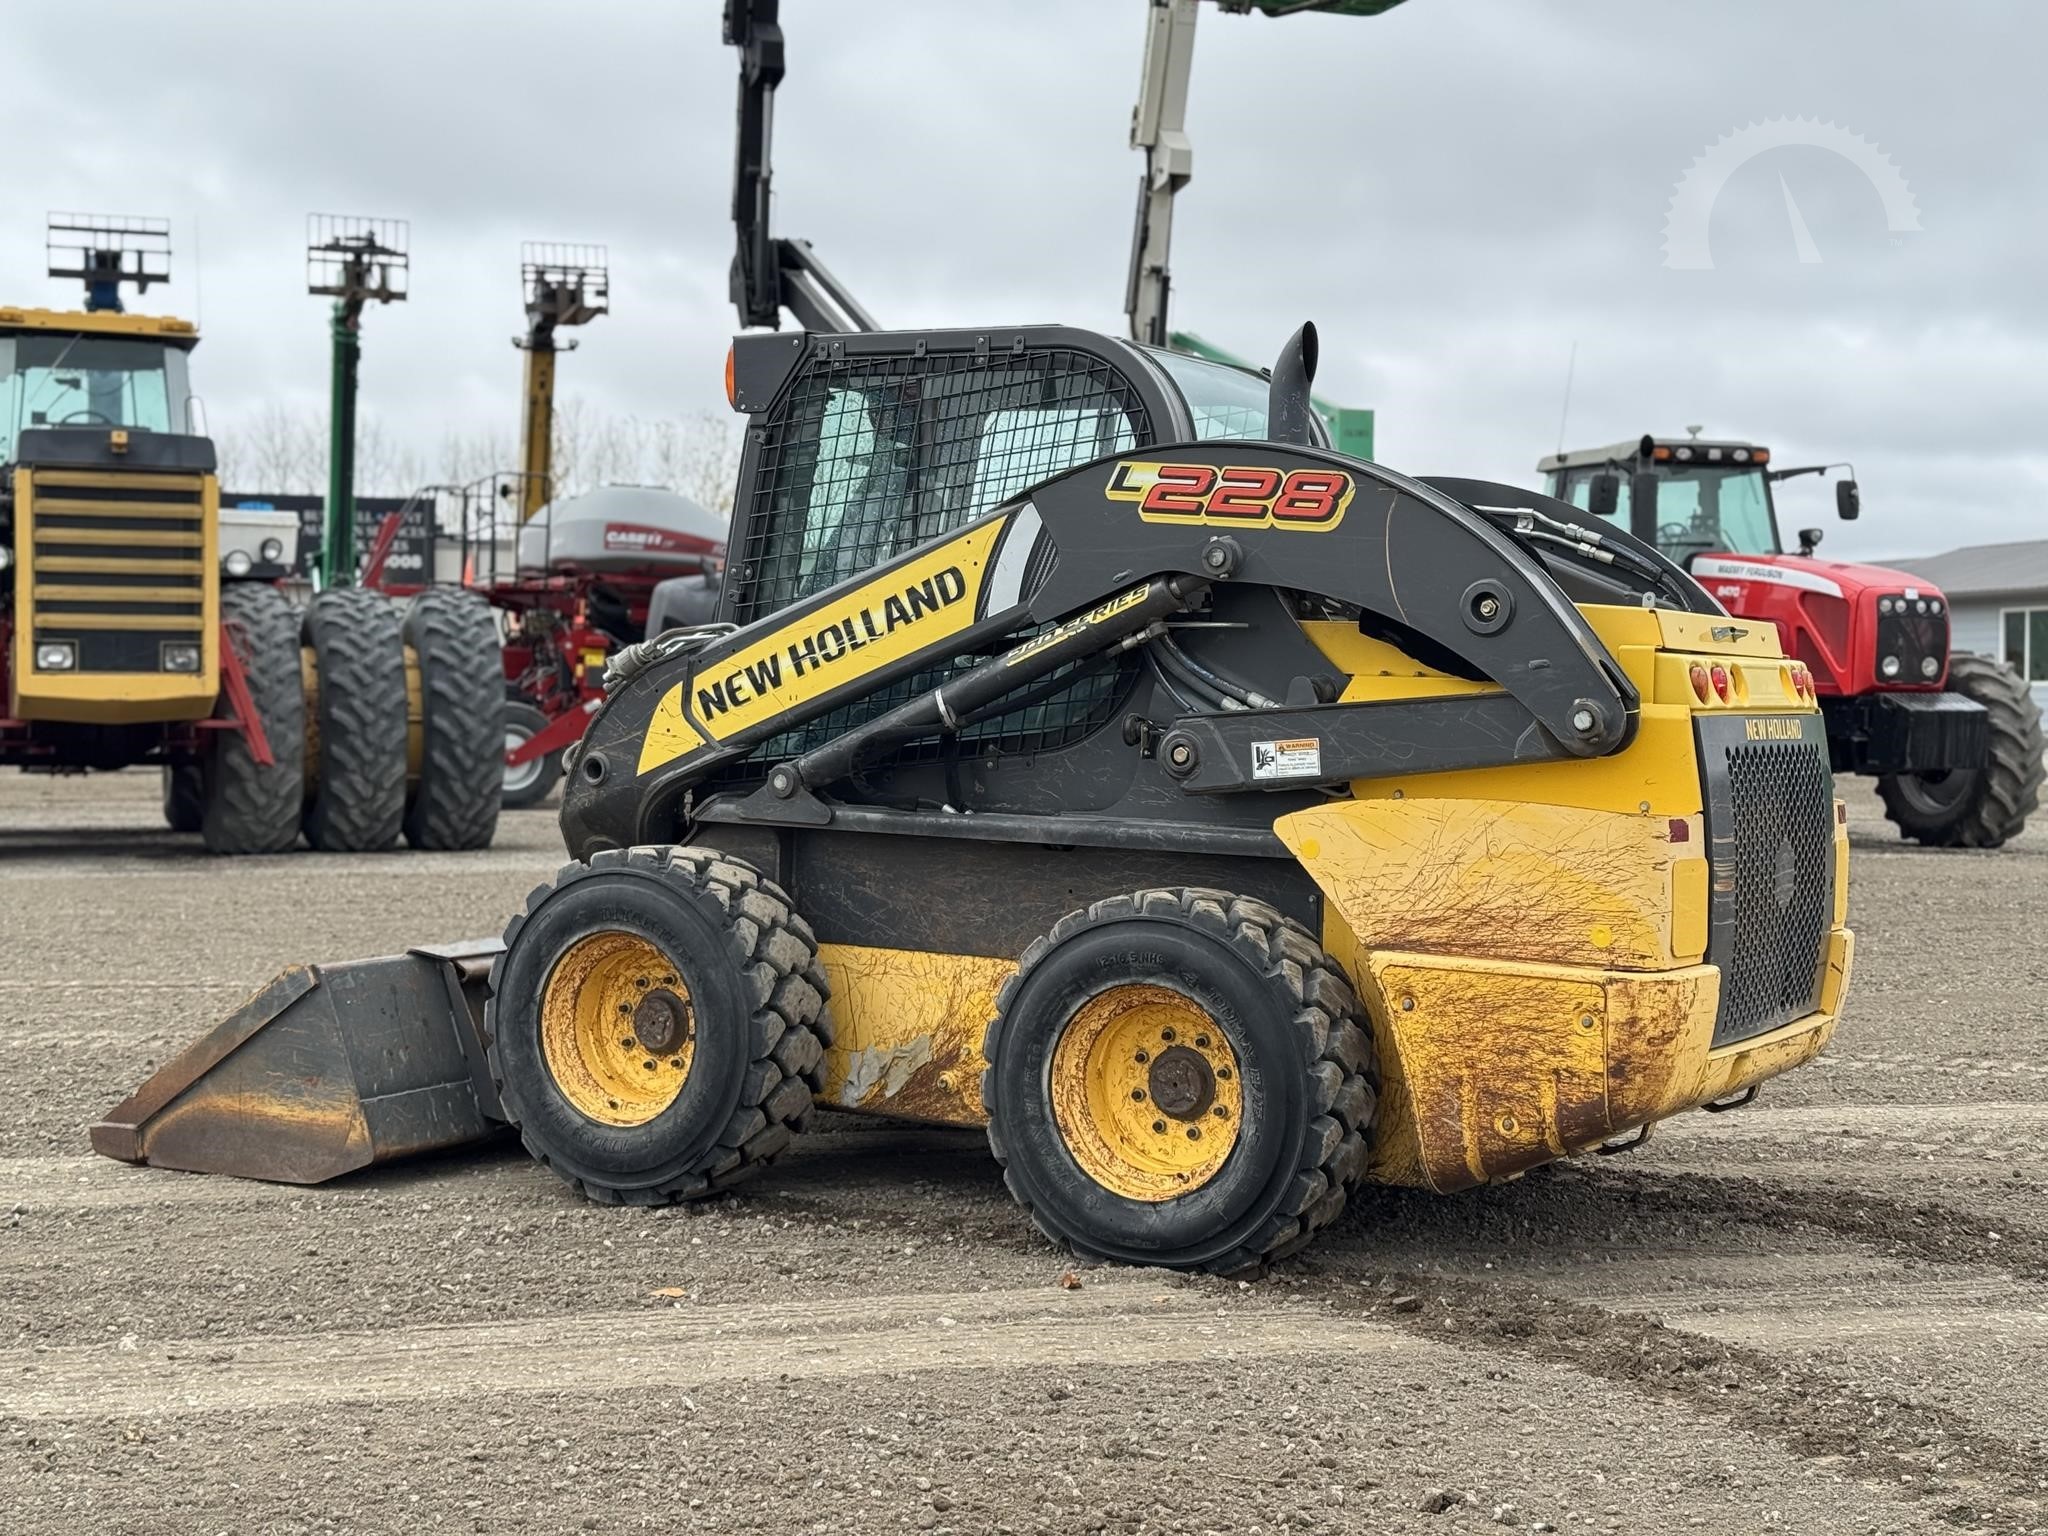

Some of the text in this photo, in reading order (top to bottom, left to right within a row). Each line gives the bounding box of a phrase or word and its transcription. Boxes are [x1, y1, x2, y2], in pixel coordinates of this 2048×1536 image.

[1107, 465, 1346, 523] L228
[697, 566, 967, 721] NEW HOLLAND
[1745, 719, 1802, 740] NEW HOLLAND
